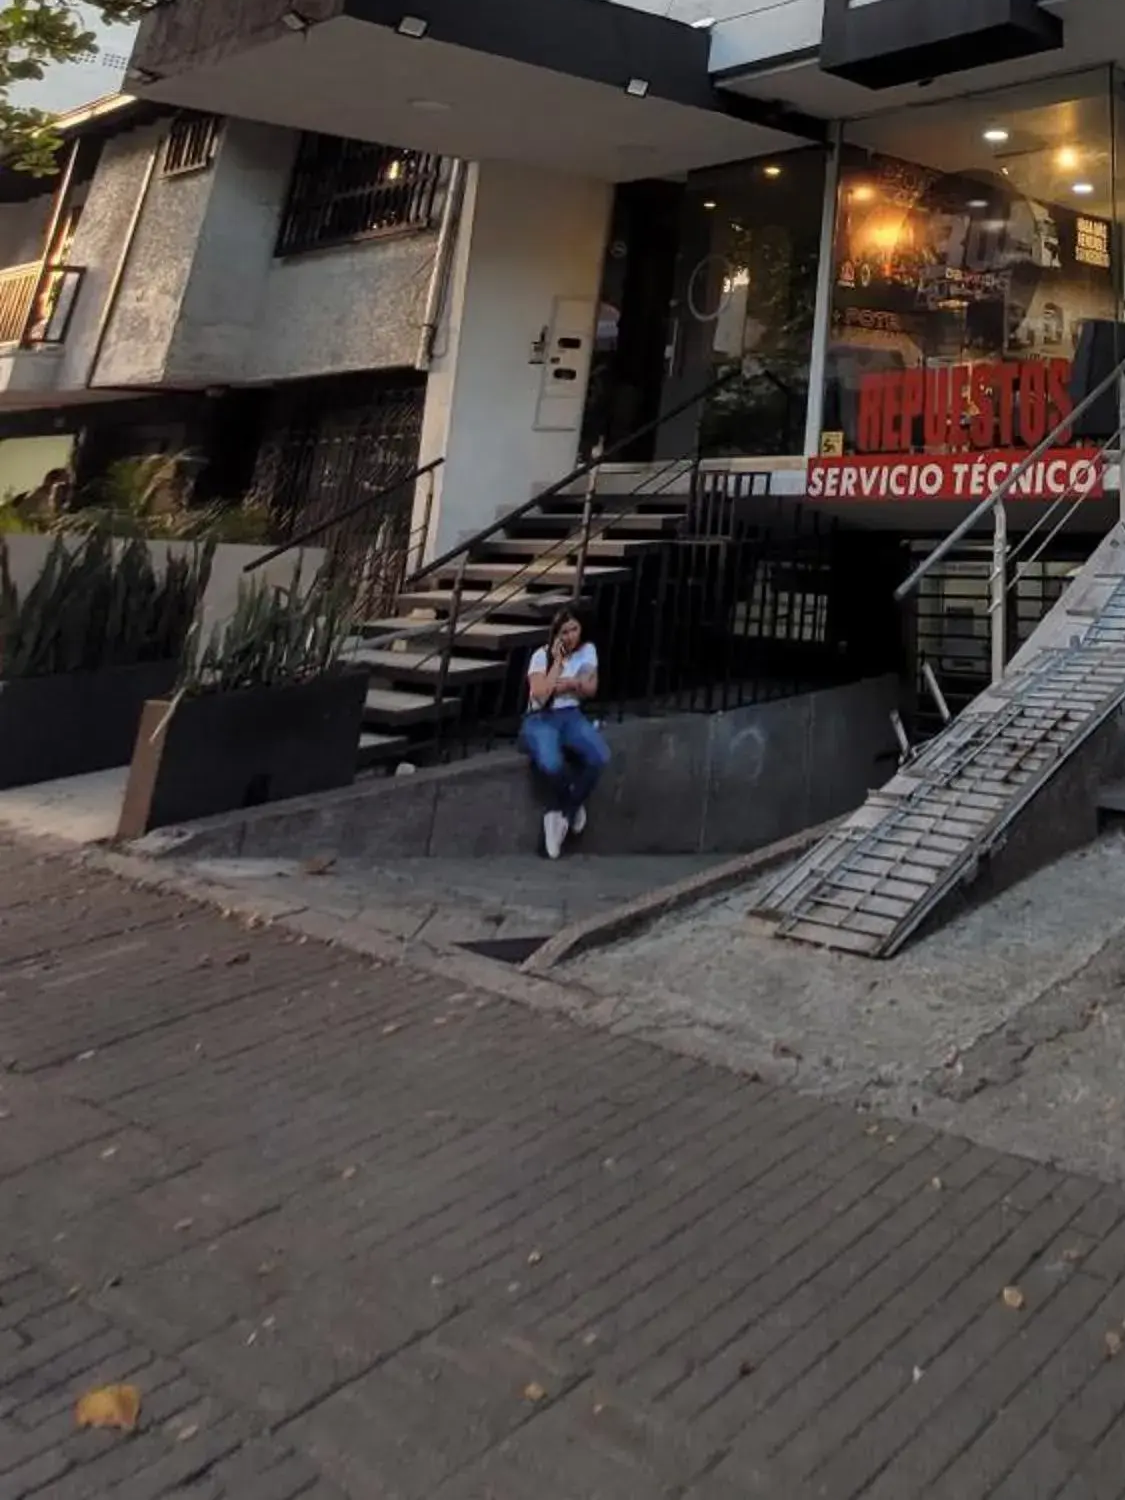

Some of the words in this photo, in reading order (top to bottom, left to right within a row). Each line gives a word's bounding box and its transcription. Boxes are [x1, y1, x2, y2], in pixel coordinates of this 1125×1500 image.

[858, 357, 1073, 452] REPUESTOS
[807, 463, 943, 497] SERVICIO
[953, 453, 1098, 495] TÉCNICO
